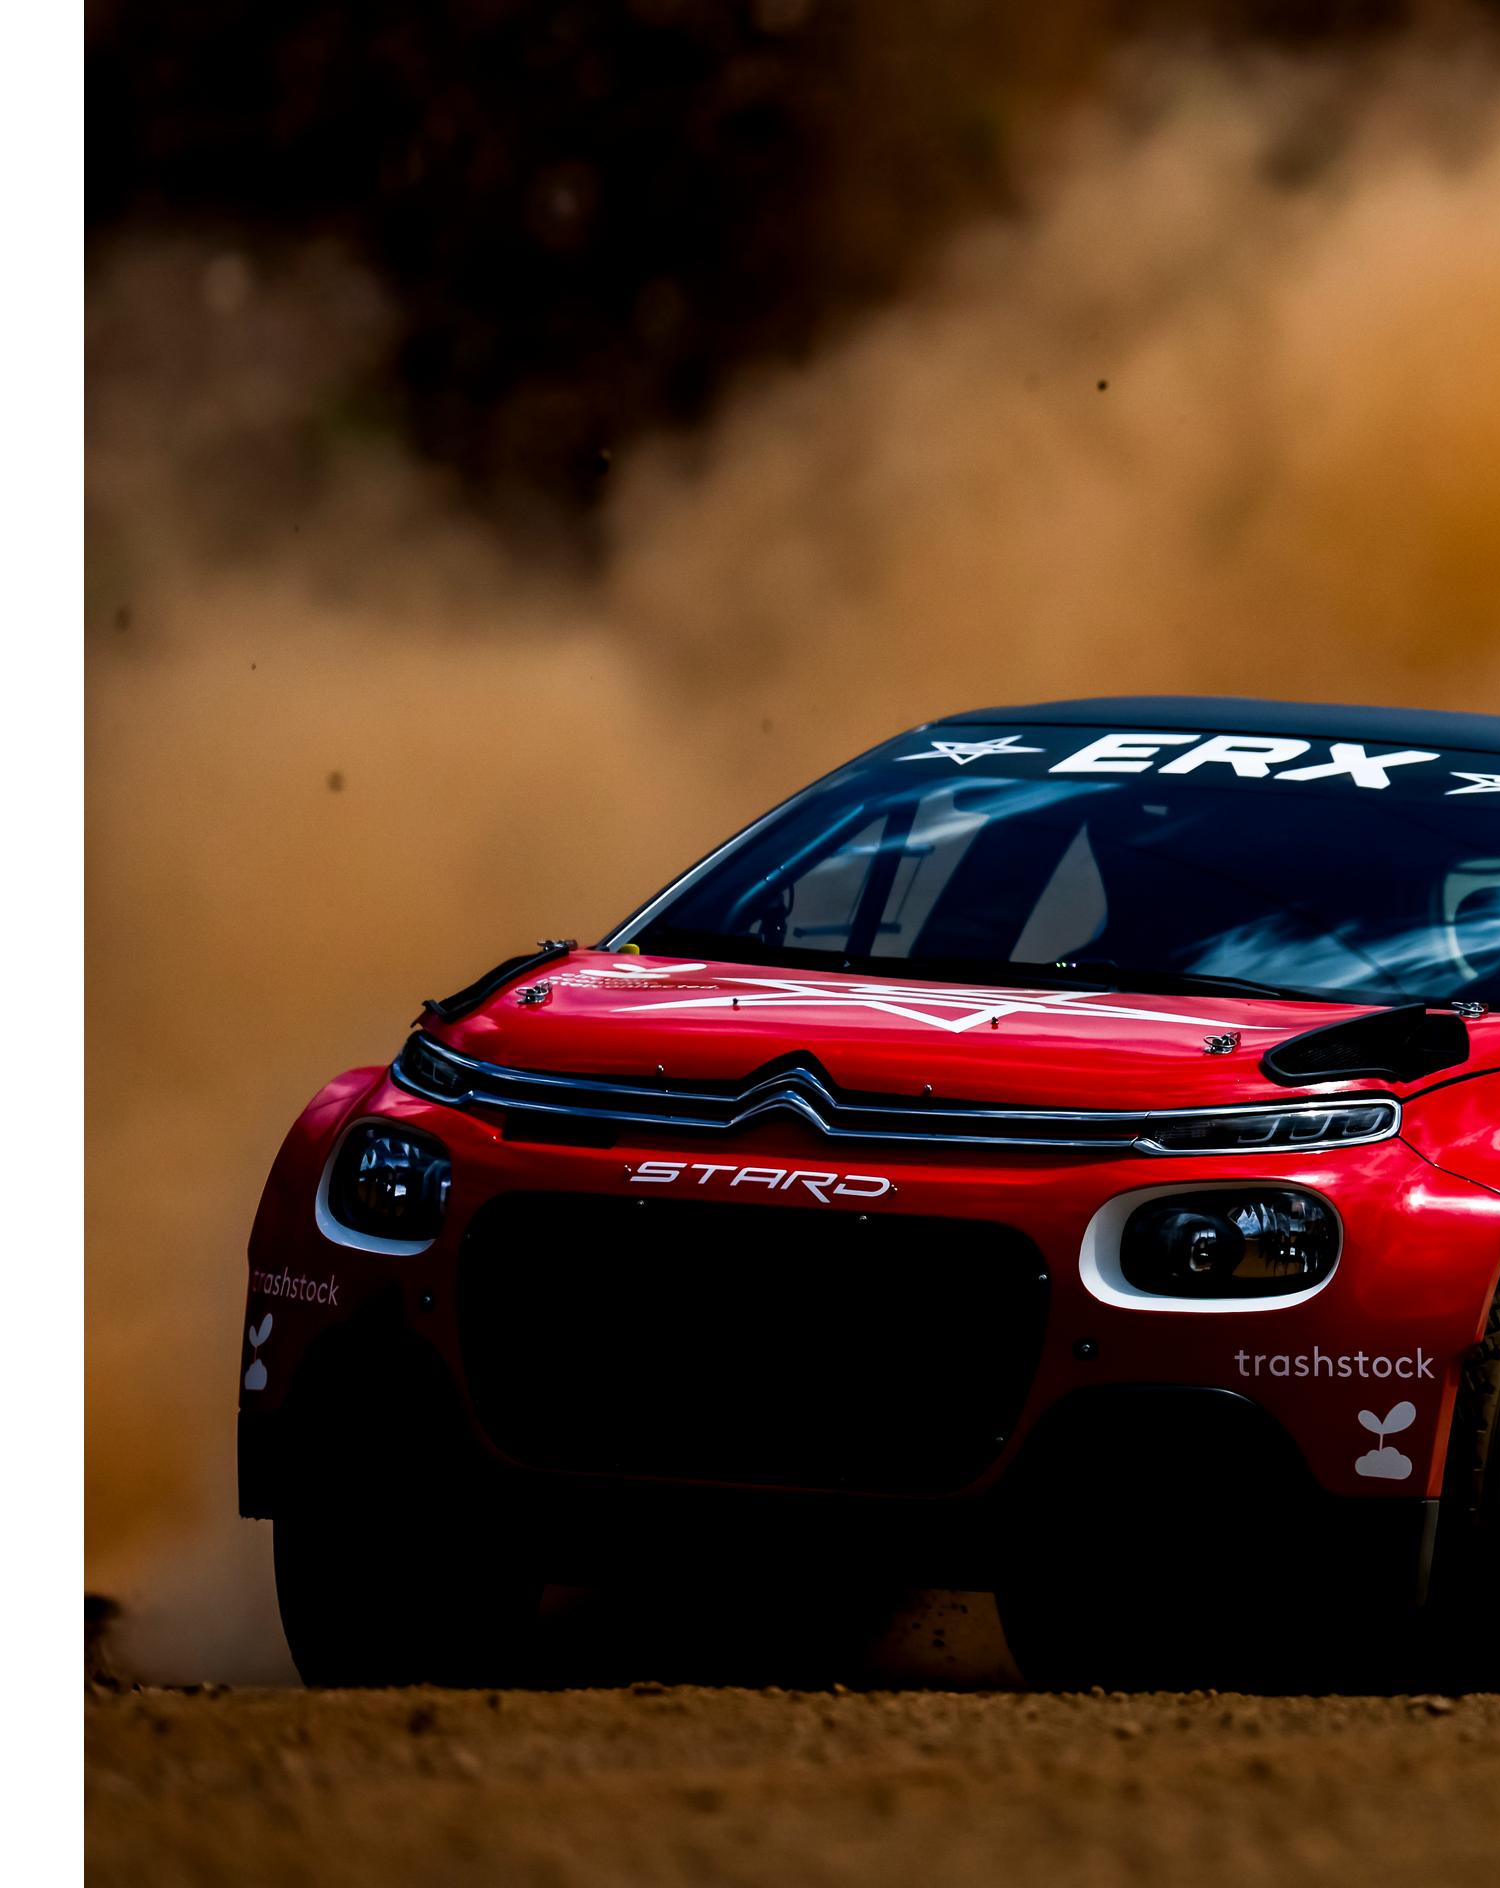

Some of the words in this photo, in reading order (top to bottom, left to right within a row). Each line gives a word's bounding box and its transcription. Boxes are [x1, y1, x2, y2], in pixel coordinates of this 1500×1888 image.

[1048, 733, 1441, 790] ERX
[630, 1161, 891, 1203] STARD
[1234, 1346, 1435, 1379] trashstock
